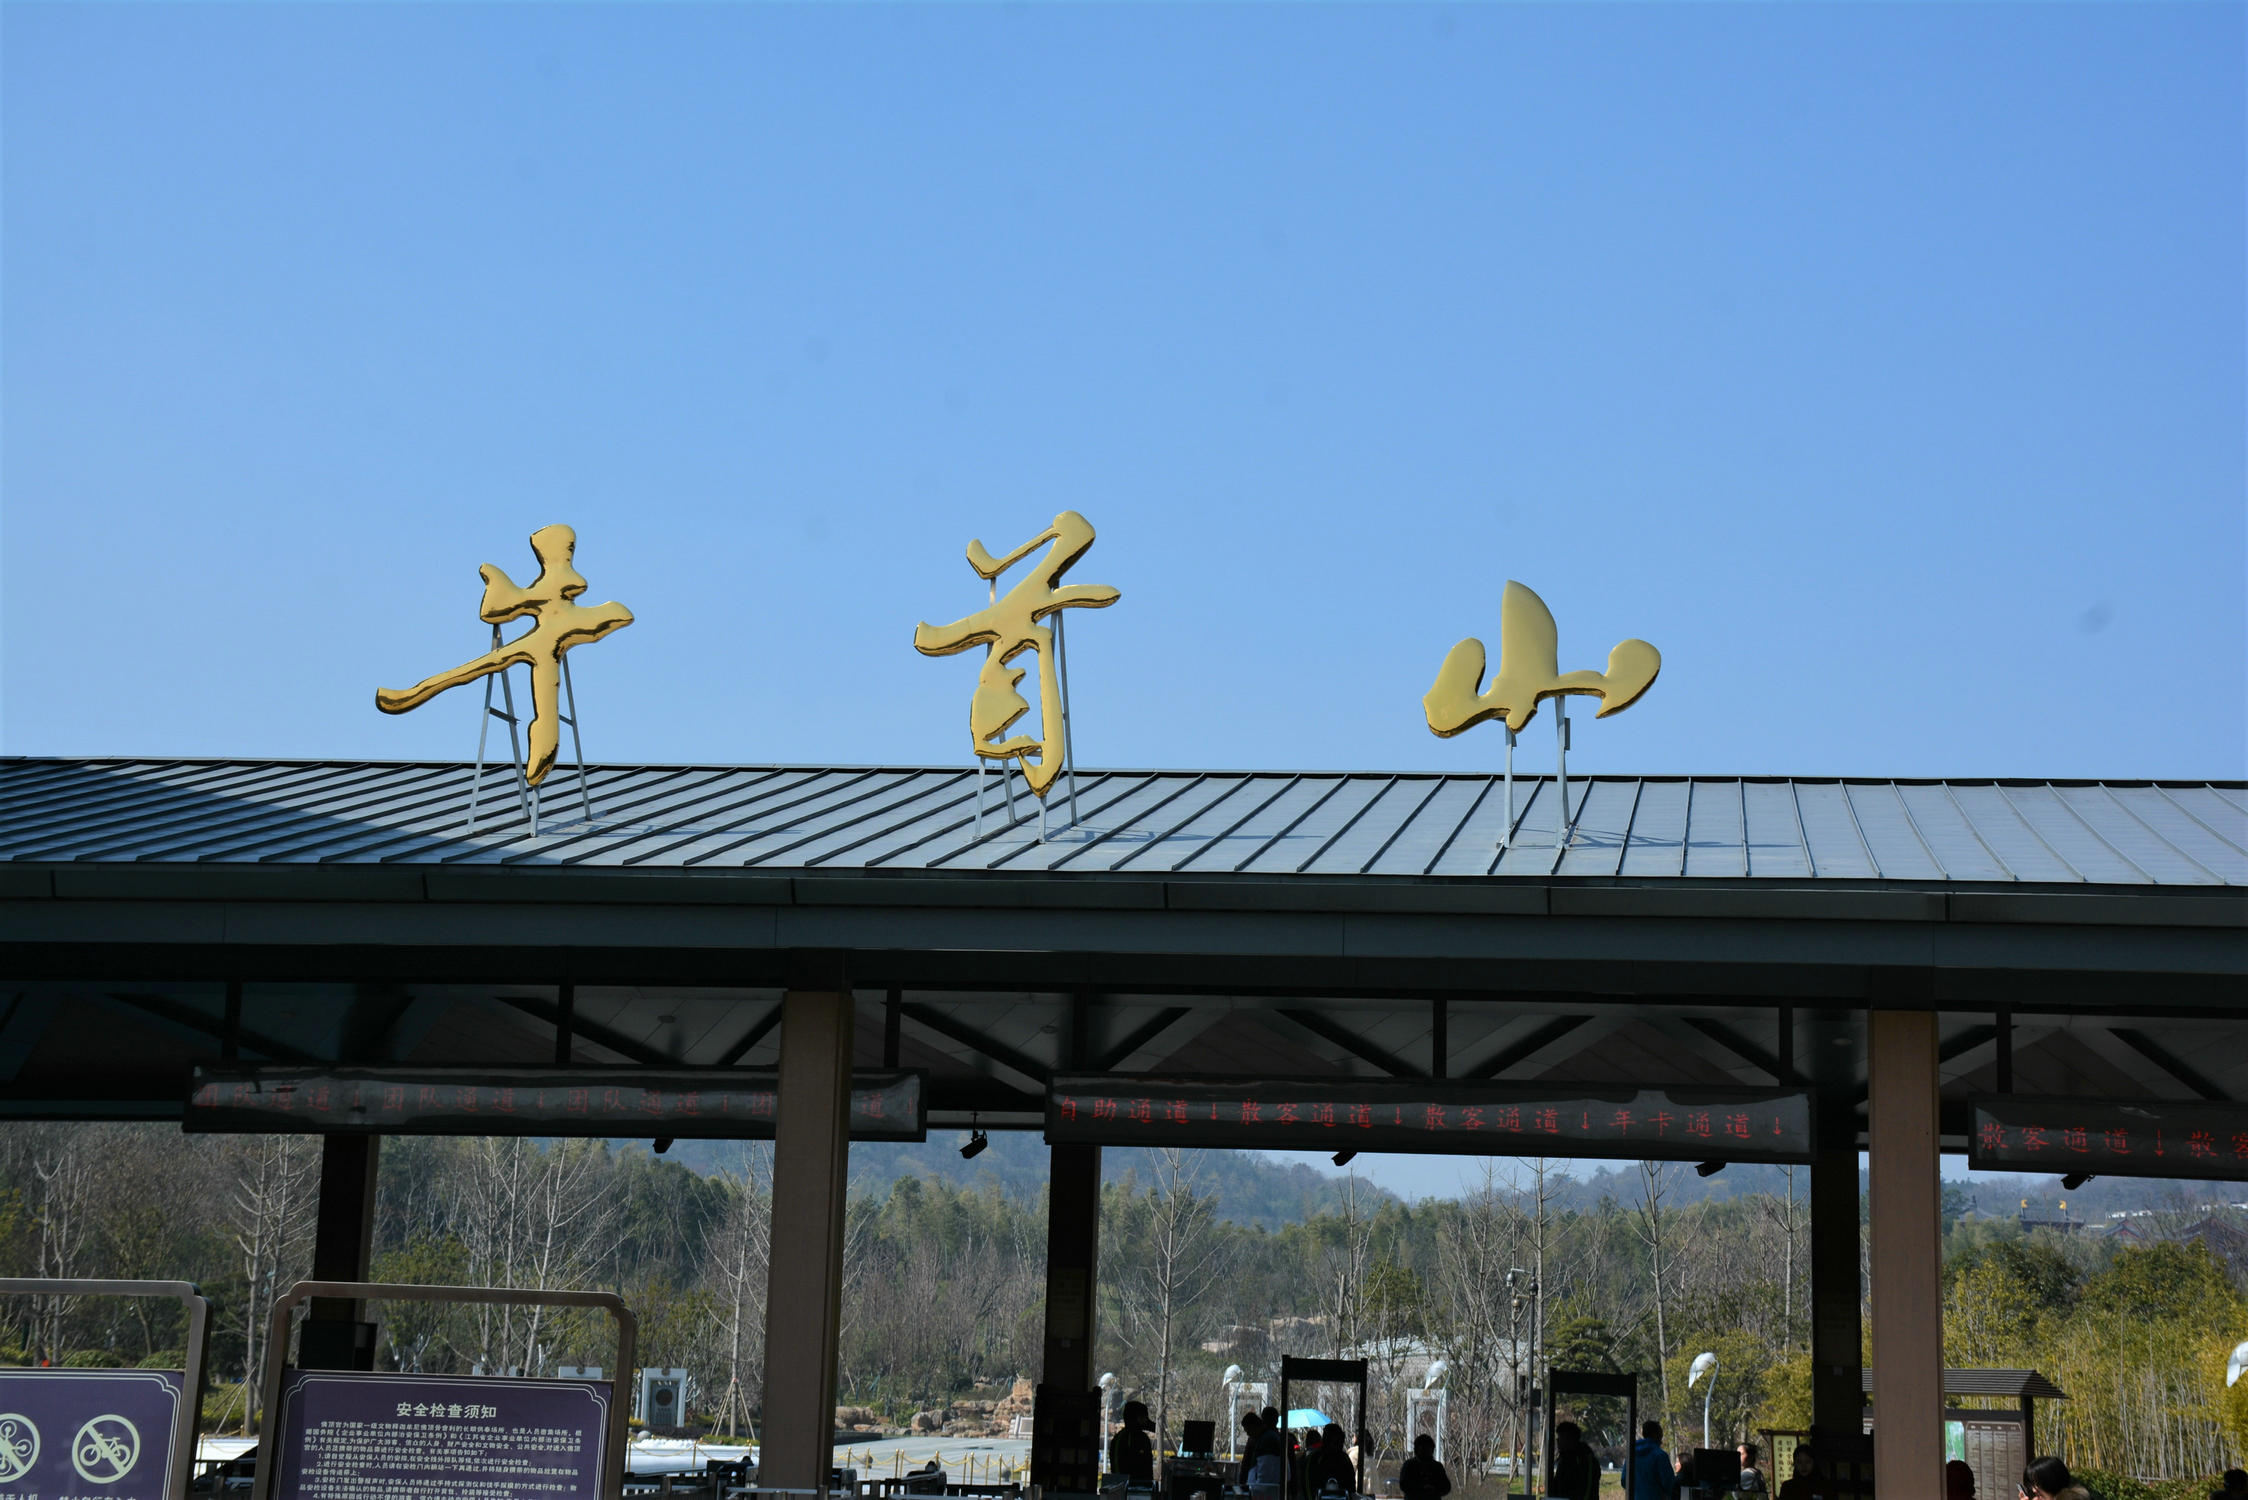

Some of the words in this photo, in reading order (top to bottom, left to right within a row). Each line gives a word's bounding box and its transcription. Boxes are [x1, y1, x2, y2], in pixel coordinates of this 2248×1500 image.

[383, 1087, 515, 1113] 团队通道
[567, 1089, 700, 1116] 团队通道
[1060, 1097, 1190, 1124] 自助通道
[1237, 1098, 1374, 1129] 散客通道
[1422, 1106, 1559, 1134] 散客通道
[1608, 1110, 1752, 1139] 年卡通道
[1978, 1123, 2134, 1155] 散客通道
[396, 1402, 498, 1419] 安全检查须知
